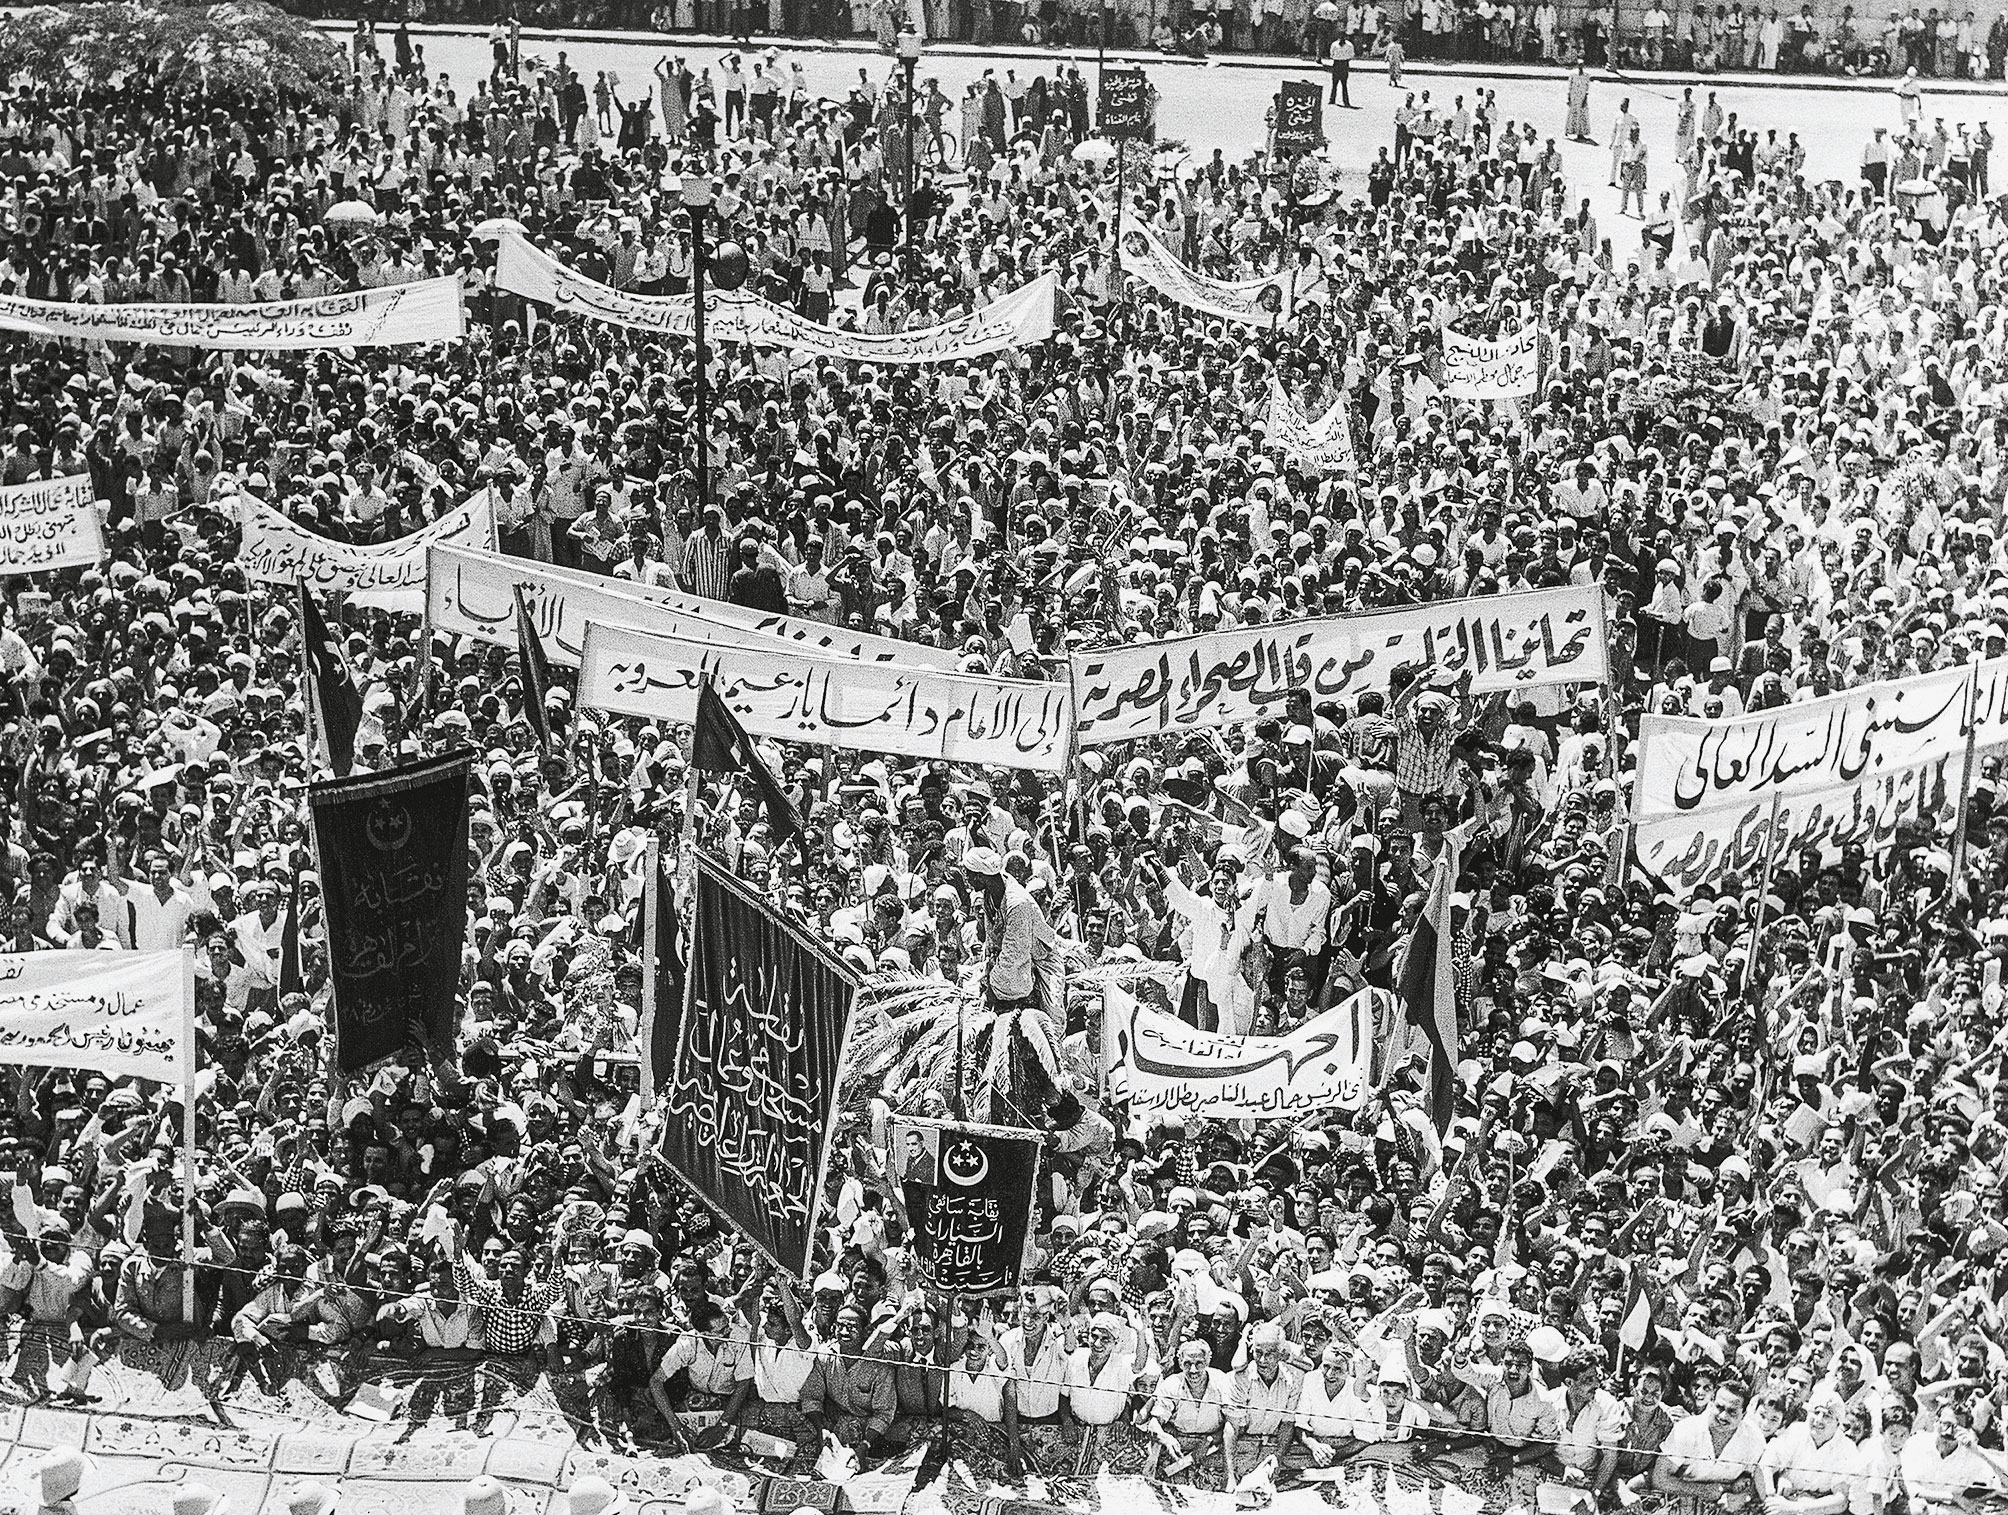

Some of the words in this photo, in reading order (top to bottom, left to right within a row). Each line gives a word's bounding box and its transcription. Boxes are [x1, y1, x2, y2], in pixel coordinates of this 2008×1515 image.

[1490, 608, 1592, 681] تهانينا
[1315, 648, 1375, 696] من
[107, 991, 146, 1017] عمال
[966, 1197, 1001, 1222] نقابة
